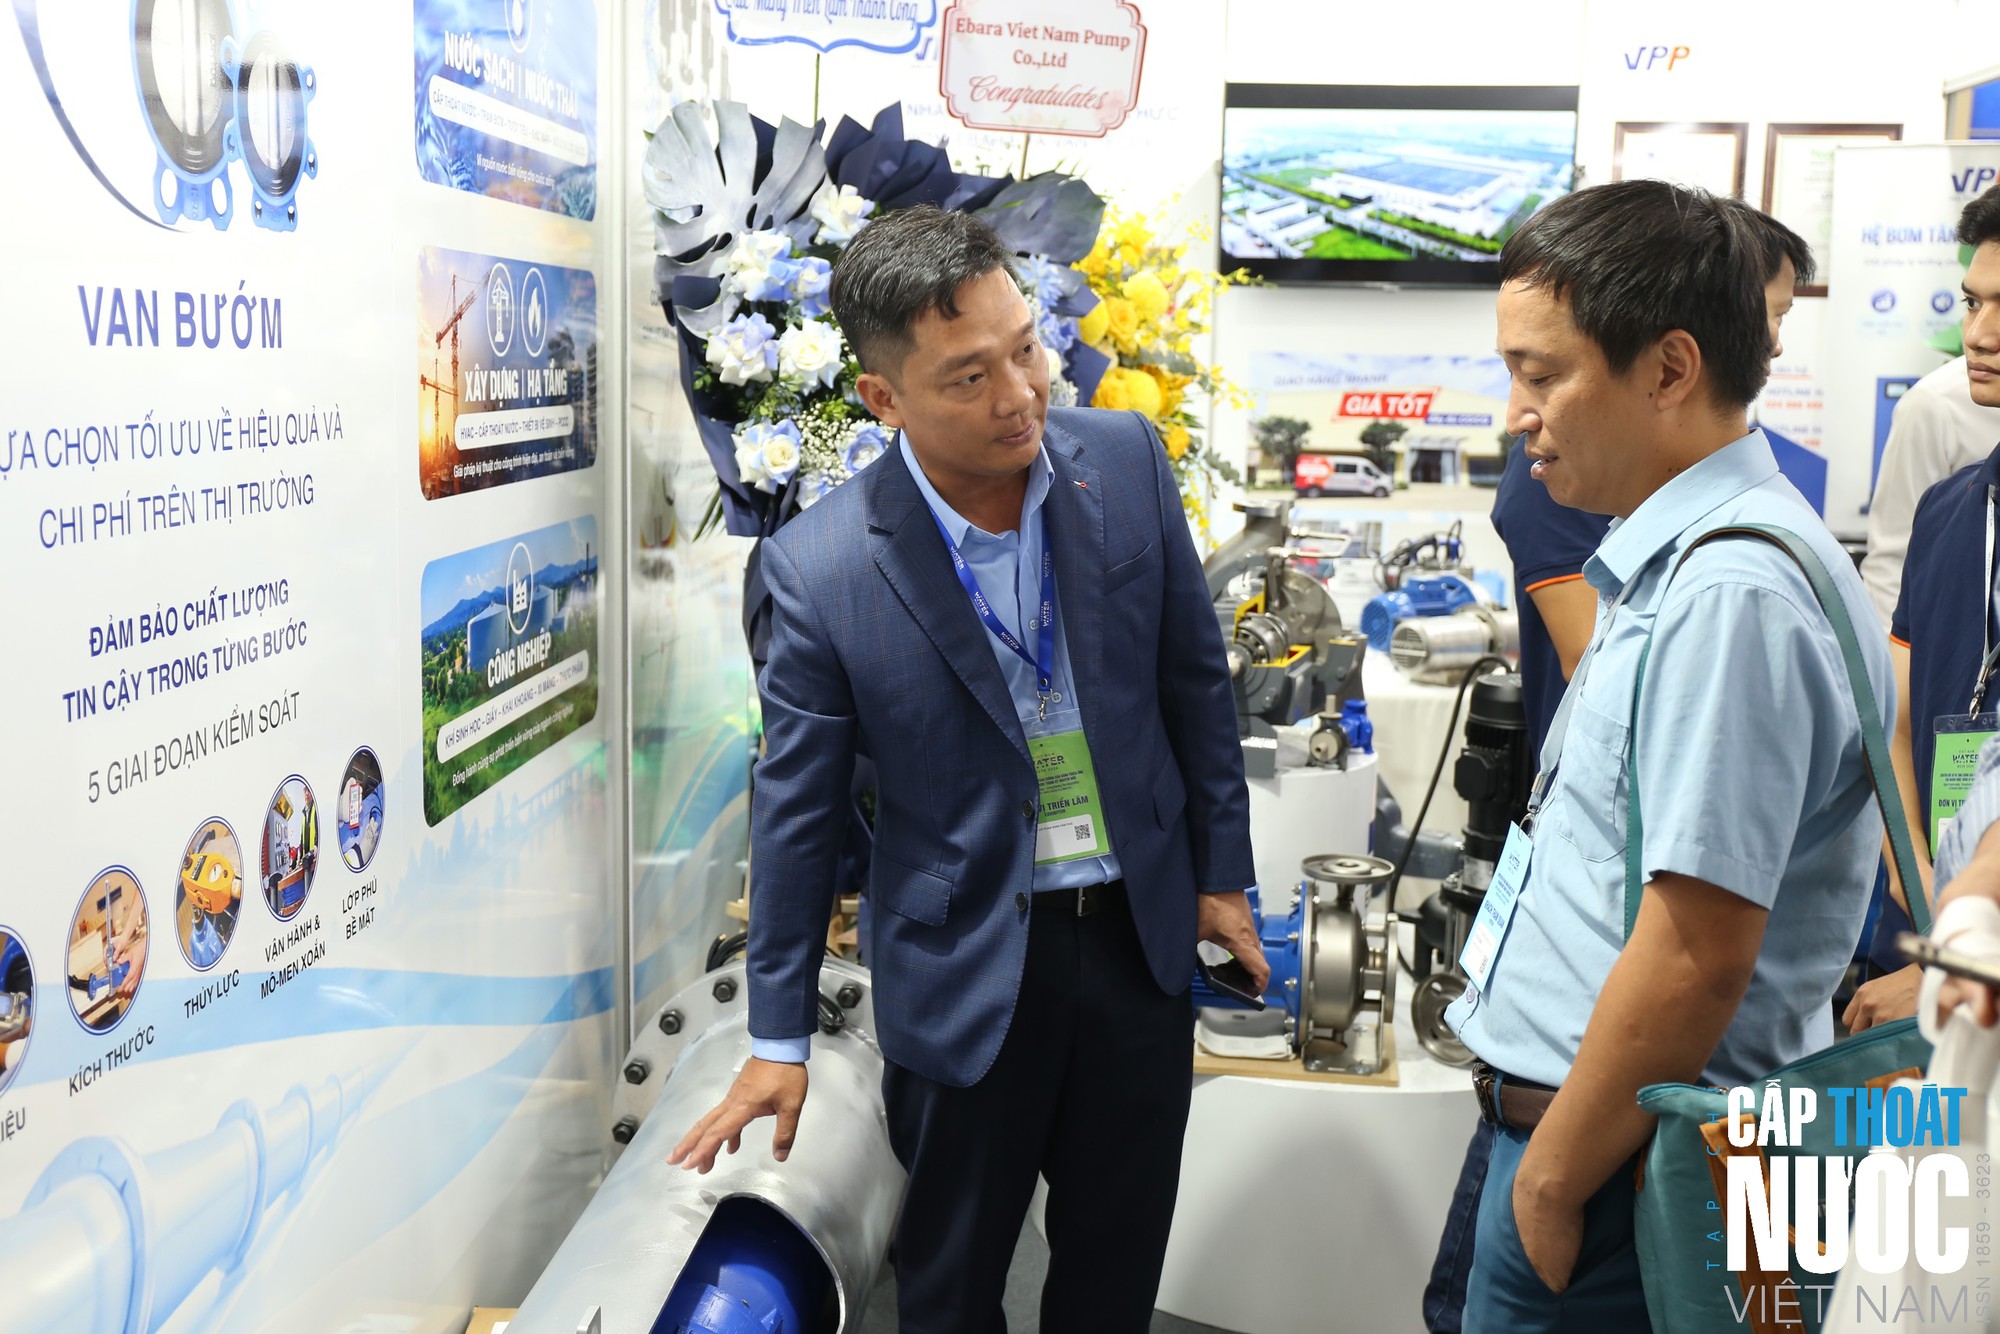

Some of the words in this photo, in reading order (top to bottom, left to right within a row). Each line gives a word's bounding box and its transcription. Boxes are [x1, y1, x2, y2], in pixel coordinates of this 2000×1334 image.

[955, 17, 1002, 36] Ebara
[1006, 22, 1038, 40] Viet
[1042, 26, 1079, 44] Nam
[1084, 29, 1131, 51] Pump
[444, 30, 481, 78] NƯỚC
[483, 48, 515, 94] SẠCH
[1013, 49, 1067, 70] Co.,Ltd
[1624, 46, 1690, 71] VPP
[969, 75, 1110, 113] Congratulates
[1951, 167, 2000, 192] VP
[77, 284, 160, 347] VAN
[174, 279, 283, 350] BƯỚM
[464, 363, 488, 403] XÂY
[490, 367, 519, 408] DỰNG
[527, 369, 542, 405] HẠ
[1345, 393, 1382, 416] GIÁ
[1387, 393, 1430, 417] TỐT
[0, 429, 38, 481] ỰA
[44, 424, 119, 472] CHỌN
[125, 409, 162, 460] TỐI
[169, 418, 201, 457] ƯU
[208, 406, 234, 452] VỀ
[239, 408, 280, 453] HIỆU
[285, 405, 319, 446] QUẢ
[323, 403, 344, 440] VÀ
[39, 504, 84, 549] CHI
[93, 490, 131, 541] PHÍ
[137, 484, 196, 533] TRÊN
[201, 485, 232, 525] THỊ
[237, 470, 314, 516] TRƯỜNG
[89, 614, 134, 657] ĐẢM
[139, 602, 179, 645] BẢO
[183, 586, 228, 632] CHẤT
[232, 579, 289, 620] LƯỢNG
[974, 591, 990, 617] WATER
[62, 685, 97, 723] TIN
[102, 668, 144, 712] CẬY
[147, 651, 209, 696] TRONG
[212, 634, 259, 675] TỪNG
[263, 617, 308, 659] BƯỚC
[487, 648, 516, 688] CÔNG
[517, 627, 552, 673] NGHIỆP
[87, 770, 101, 804] 5
[107, 750, 149, 797] GIAI
[154, 727, 208, 777] ĐOẠN
[212, 704, 254, 753] KIỂM
[258, 689, 300, 734] SOÁT
[455, 724, 469, 743] SINH
[1036, 755, 1065, 769] ATER
[341, 889, 360, 915] LỚP
[361, 876, 378, 905] PHỦ
[265, 934, 286, 963] VẬN
[287, 921, 312, 954] HÀNH
[313, 914, 321, 932] &
[345, 914, 358, 940] BỀ
[357, 906, 375, 936] MẶT
[260, 965, 299, 1000] MÔ-MEN
[301, 937, 326, 974] XOẮN
[184, 988, 213, 1020] THỦY
[216, 969, 240, 1001] LỰC
[69, 1057, 103, 1097] KÍCH
[105, 1025, 155, 1072] THƯỚC
[0, 1106, 26, 1143] IỆU
